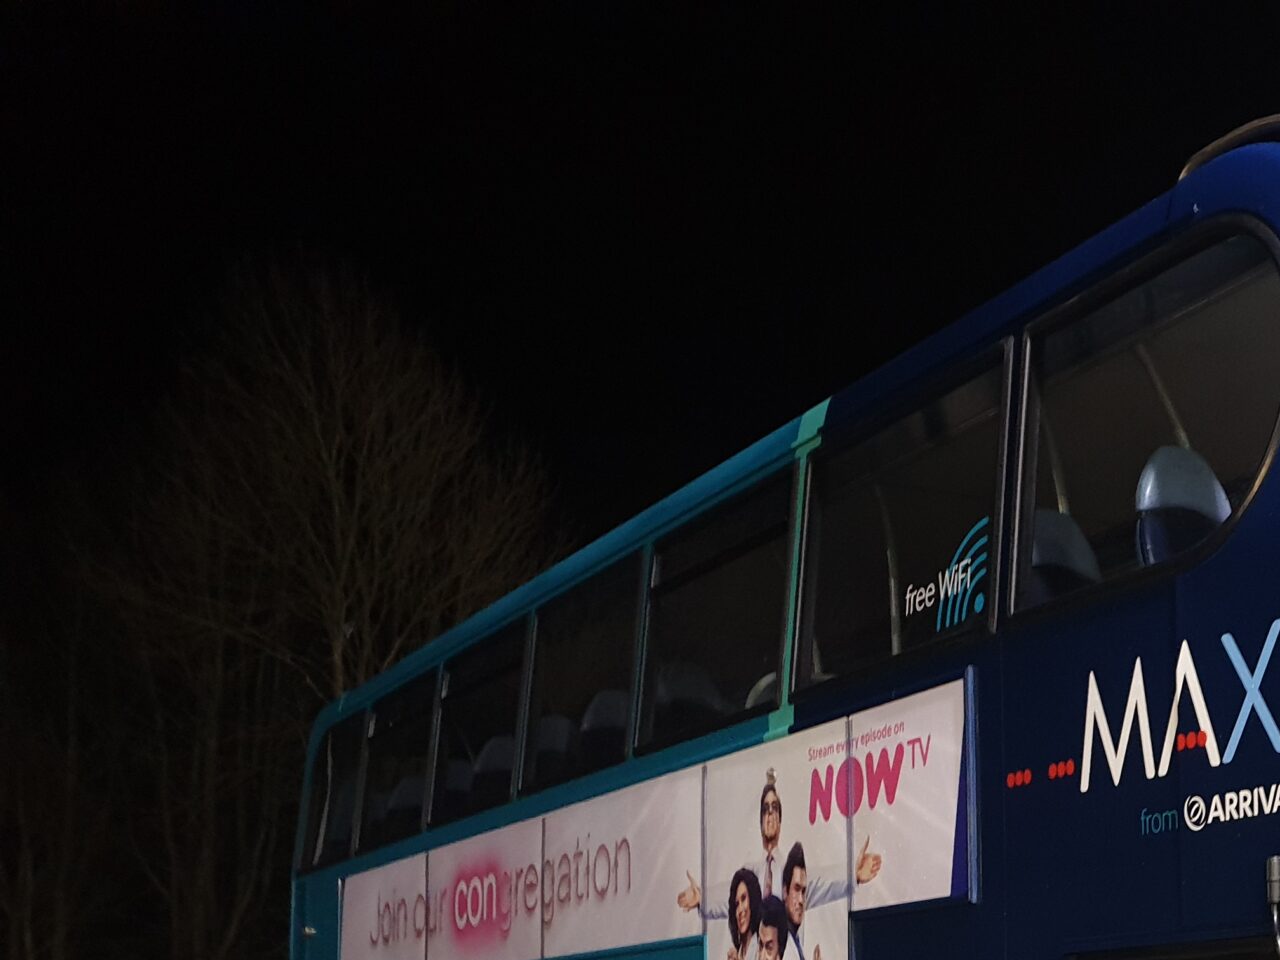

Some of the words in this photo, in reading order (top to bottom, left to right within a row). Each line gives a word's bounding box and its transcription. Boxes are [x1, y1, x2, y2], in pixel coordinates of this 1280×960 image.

[905, 583, 936, 616] free
[938, 558, 972, 600] WiFi
[808, 742, 835, 762] Stream
[860, 726, 892, 747] episode
[893, 720, 905, 735] on
[808, 743, 905, 826] NOW
[907, 733, 931, 769] TV
[1140, 807, 1179, 835] from
[369, 888, 408, 946] Join
[412, 884, 449, 939] our
[453, 833, 632, 940] congregation
